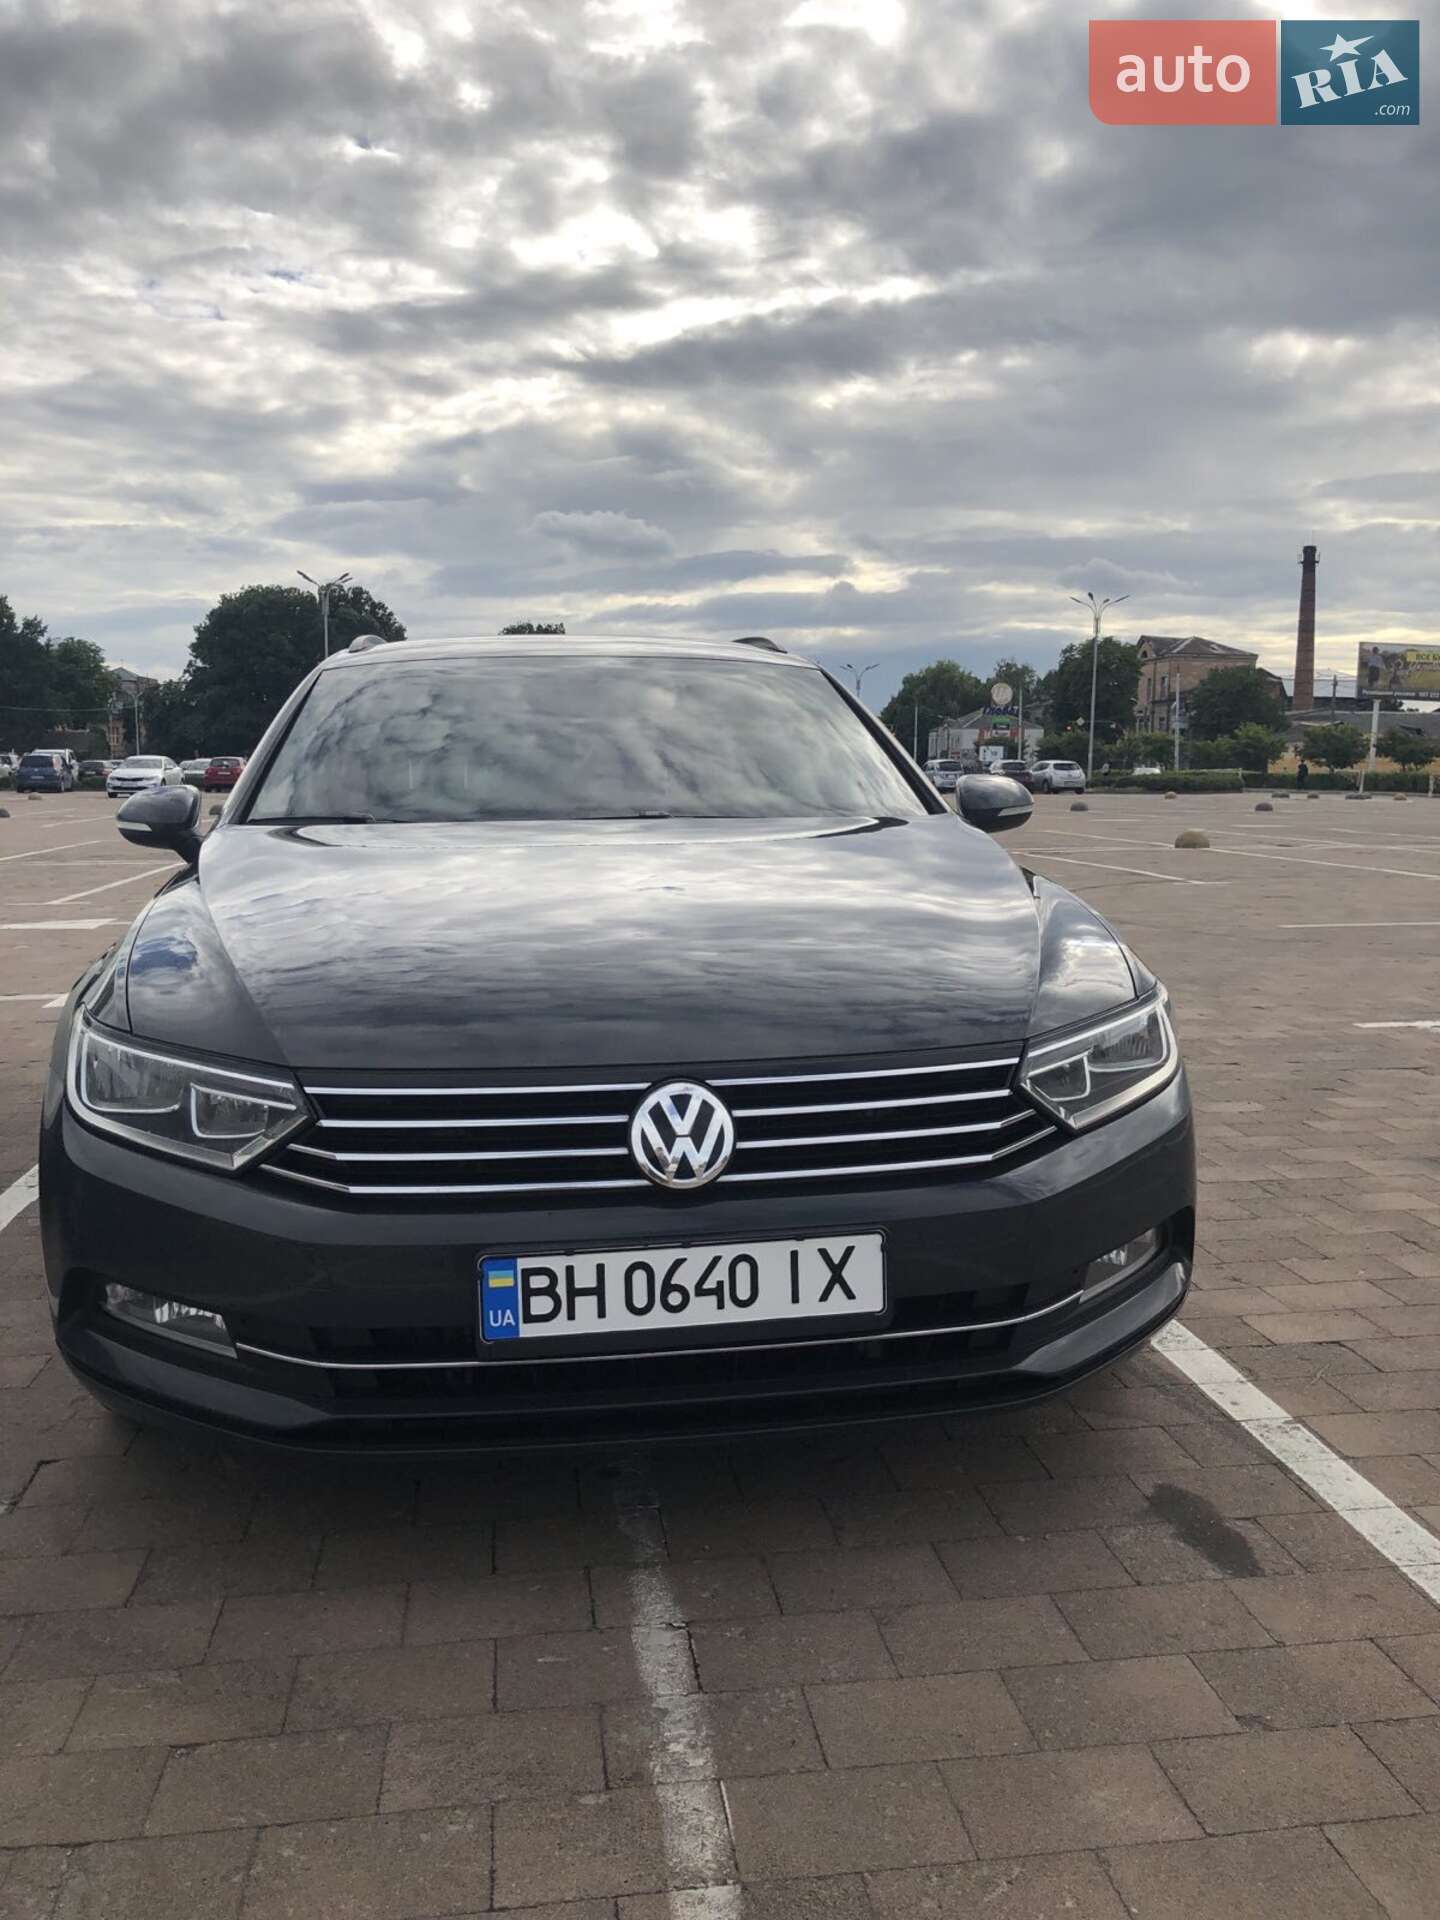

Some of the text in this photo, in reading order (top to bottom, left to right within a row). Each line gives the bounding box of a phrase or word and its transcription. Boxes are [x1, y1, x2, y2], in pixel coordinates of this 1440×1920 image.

[624, 1253, 760, 1317] 0640
[789, 1245, 857, 1304] IX
[489, 1309, 516, 1327] UA
